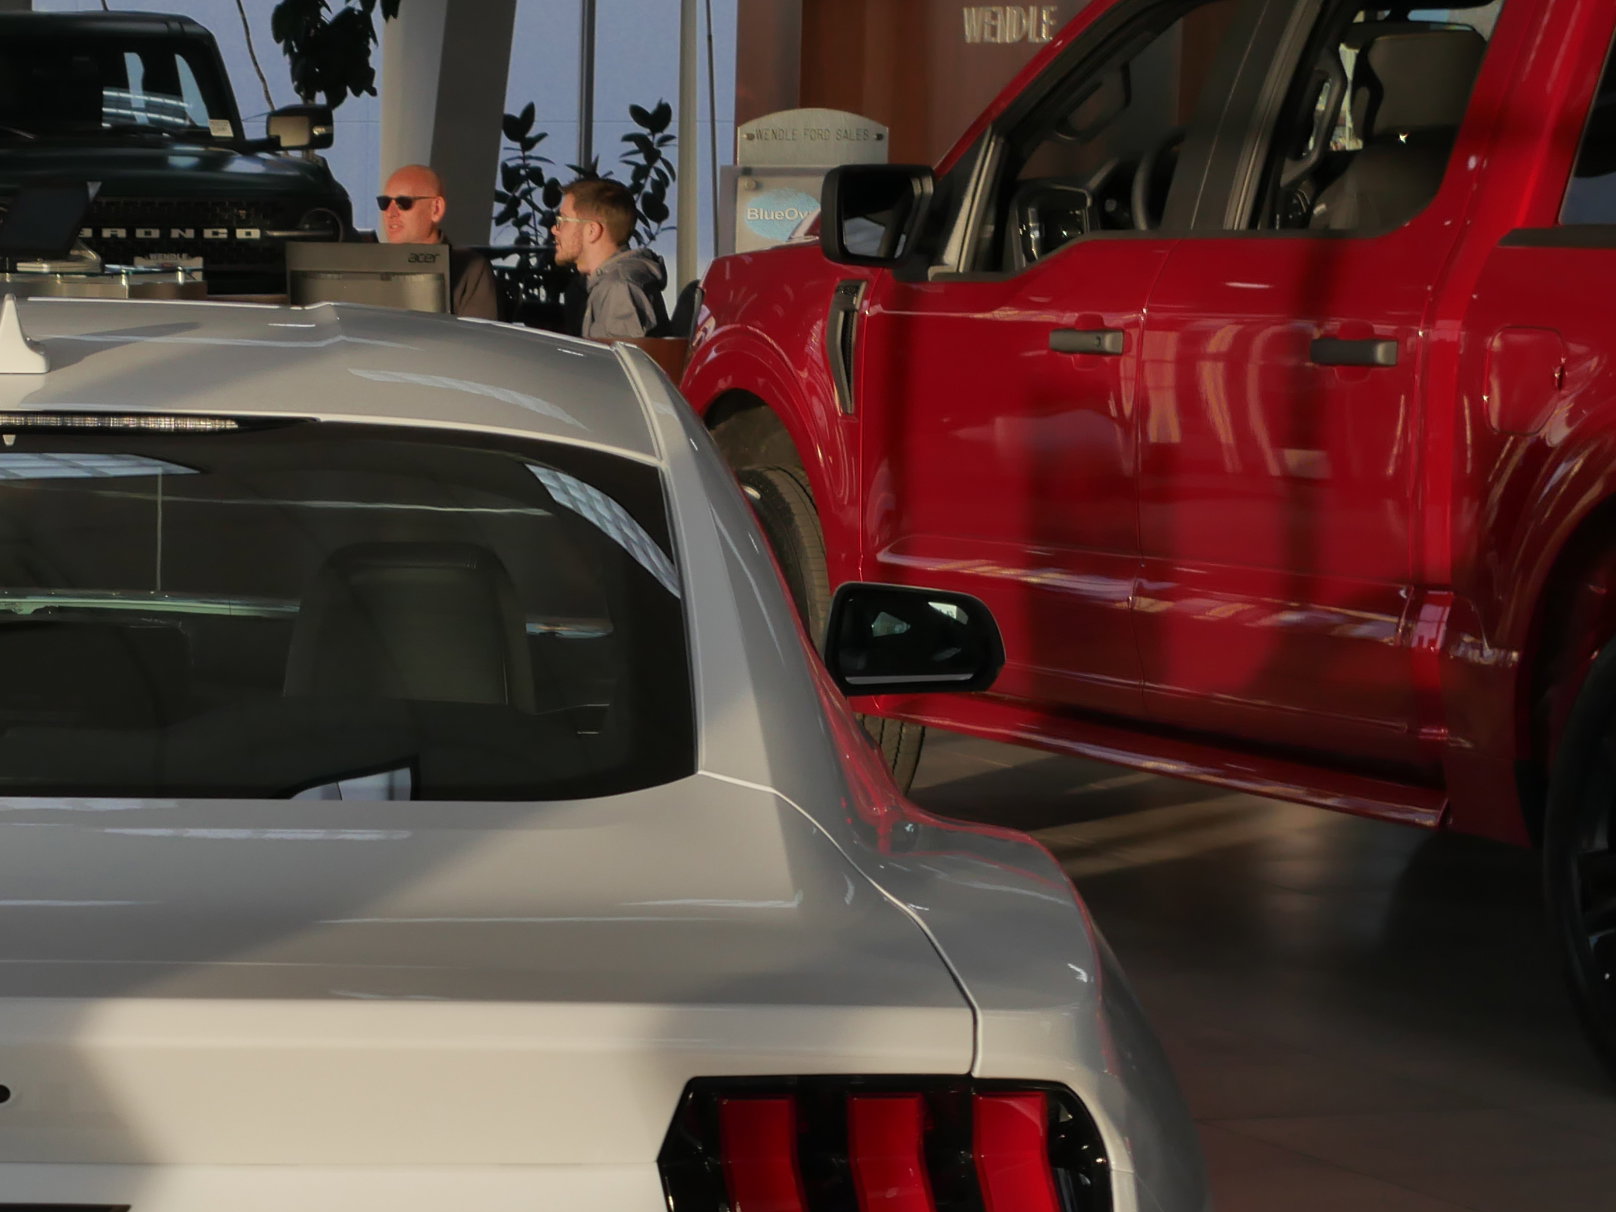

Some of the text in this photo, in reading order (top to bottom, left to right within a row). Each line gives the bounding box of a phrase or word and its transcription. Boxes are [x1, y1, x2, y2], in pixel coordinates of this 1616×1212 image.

[963, 6, 1057, 43] WENDLE
[754, 128, 870, 141] WENDLE FORD SALES
[407, 253, 441, 263] acer
